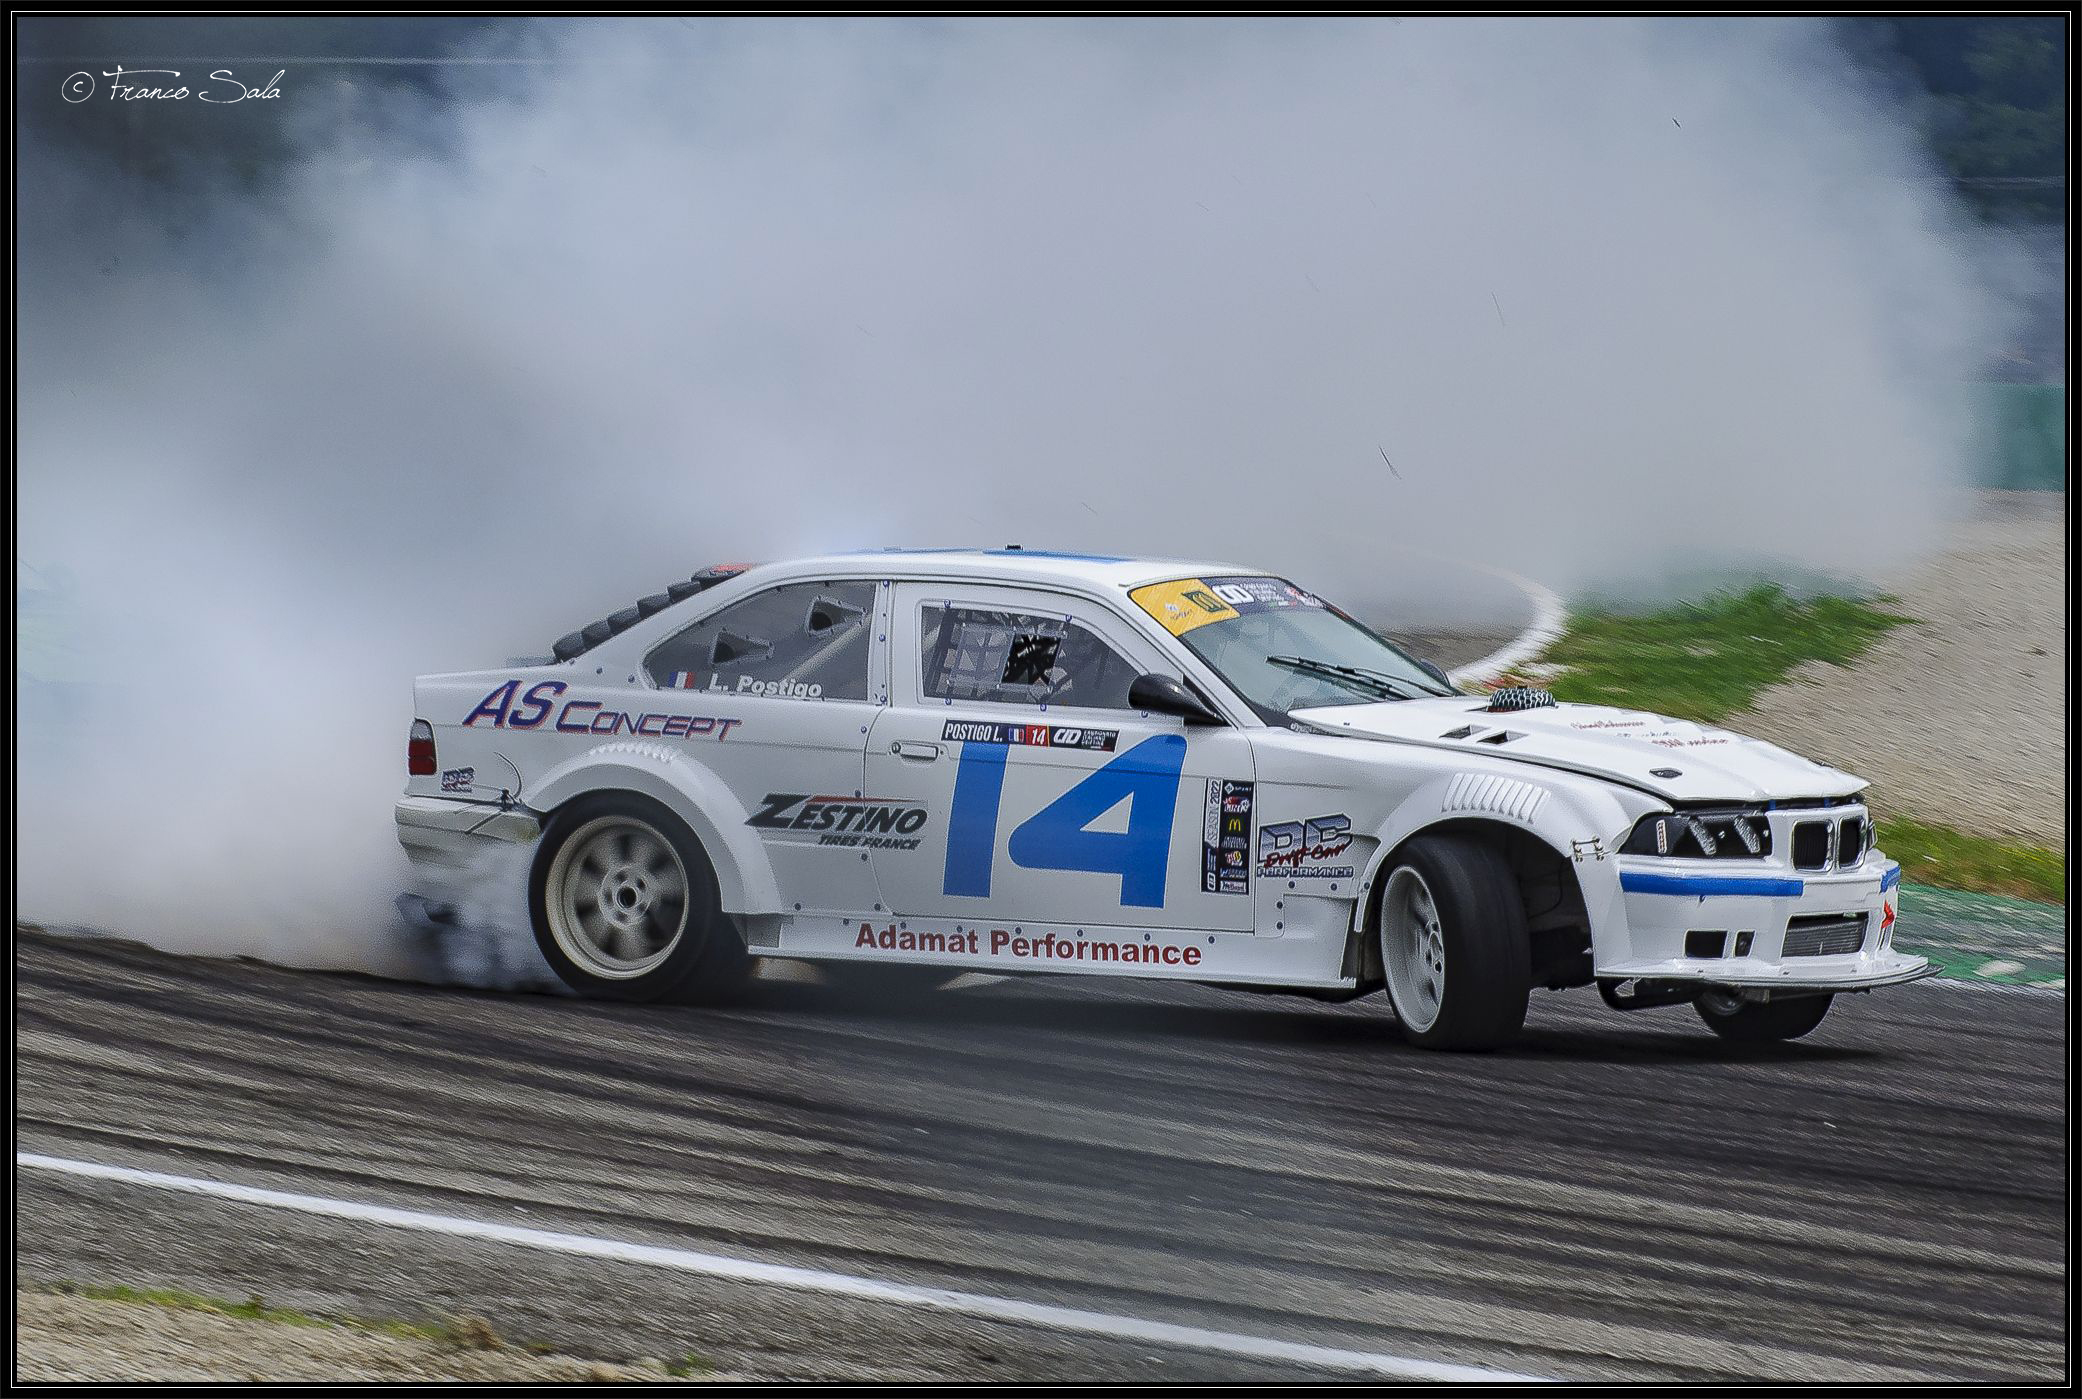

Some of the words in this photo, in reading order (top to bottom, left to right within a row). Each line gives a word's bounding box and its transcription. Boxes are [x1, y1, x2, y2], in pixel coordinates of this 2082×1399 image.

[736, 674, 822, 699] Postigo
[461, 679, 569, 731] AS
[944, 723, 991, 742] POSTIGO
[993, 726, 1003, 743] L.
[1031, 729, 1047, 745] 14
[1210, 780, 1221, 805] 2022
[744, 793, 928, 835] ZESTINO
[942, 734, 1188, 909] 14
[817, 833, 861, 848] TIRES
[860, 836, 922, 850] FRANCE
[1256, 866, 1354, 879] PERFORMANCE
[855, 922, 979, 954] Adamat
[990, 928, 1203, 966] Performance
